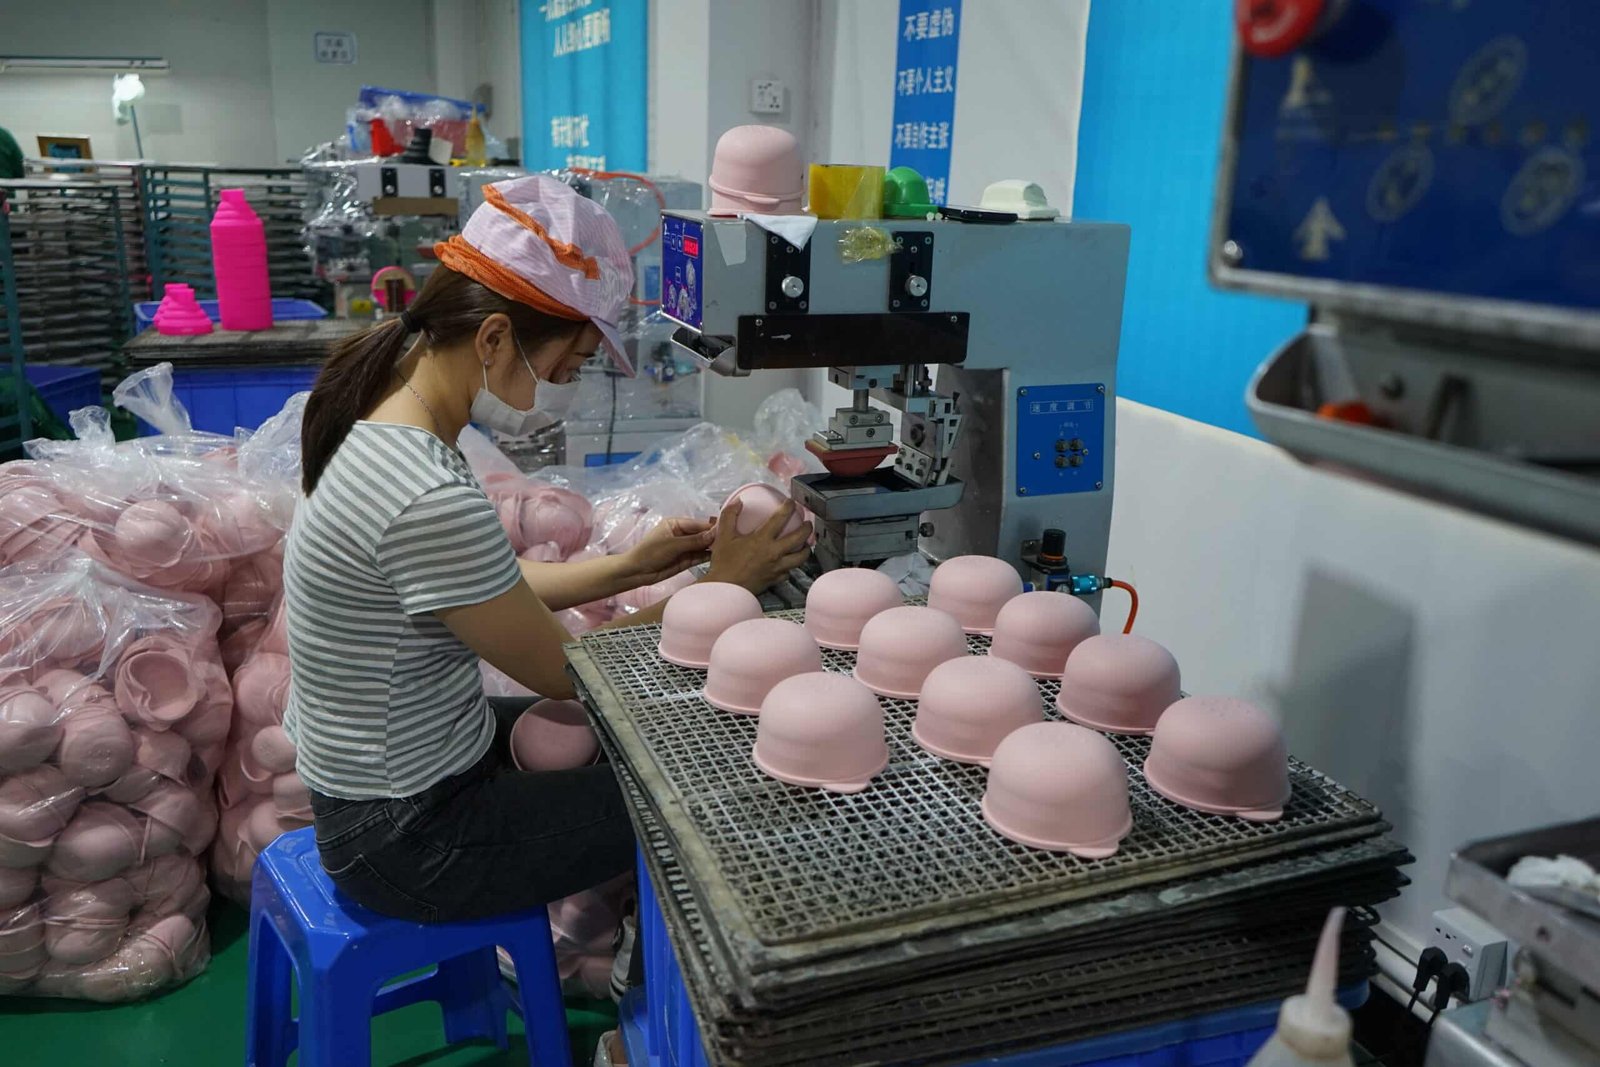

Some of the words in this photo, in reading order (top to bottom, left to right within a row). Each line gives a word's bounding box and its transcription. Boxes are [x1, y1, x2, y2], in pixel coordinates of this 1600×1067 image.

[903, 7, 954, 42] 不要虚伪
[897, 66, 954, 97] 不要个人主义
[895, 122, 949, 149] 不要自作主张
